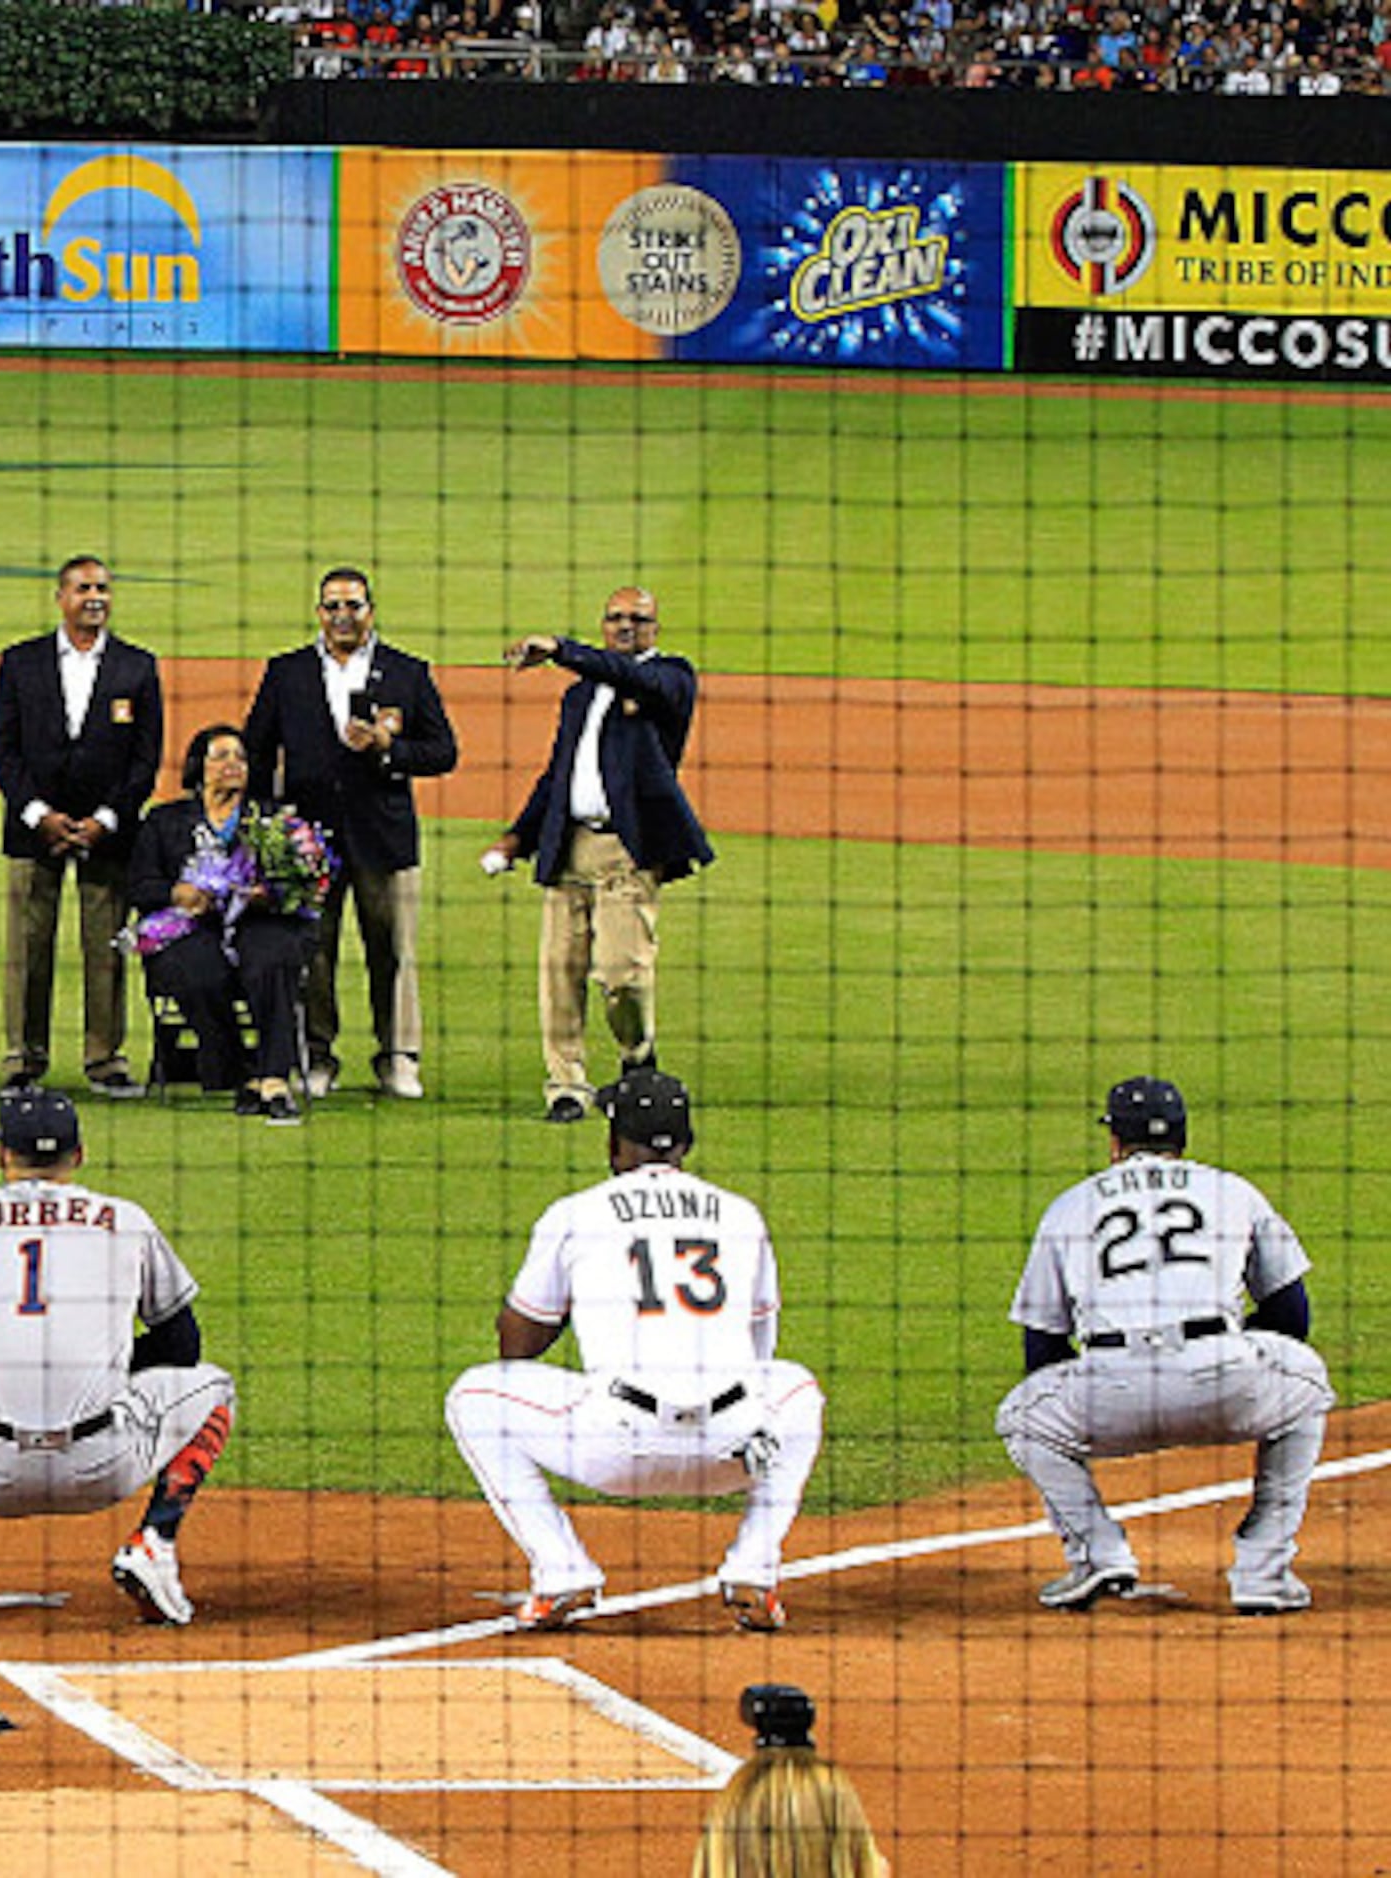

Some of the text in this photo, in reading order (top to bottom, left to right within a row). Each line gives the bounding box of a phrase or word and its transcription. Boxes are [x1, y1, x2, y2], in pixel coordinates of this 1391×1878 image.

[629, 229, 707, 249] STRIKE
[832, 213, 913, 266] OXI
[1179, 188, 1391, 247] MICC
[627, 273, 708, 294] STAINS
[642, 253, 693, 271] OUT
[798, 243, 941, 314] CLEAN
[1176, 257, 1275, 285] TRIBE
[1285, 260, 1328, 286] OF
[1094, 1166, 1192, 1200] CANO
[608, 1189, 721, 1224] OZUNA
[1094, 1197, 1211, 1281] 22
[15, 1237, 48, 1316] 1
[628, 1236, 728, 1319] 13
